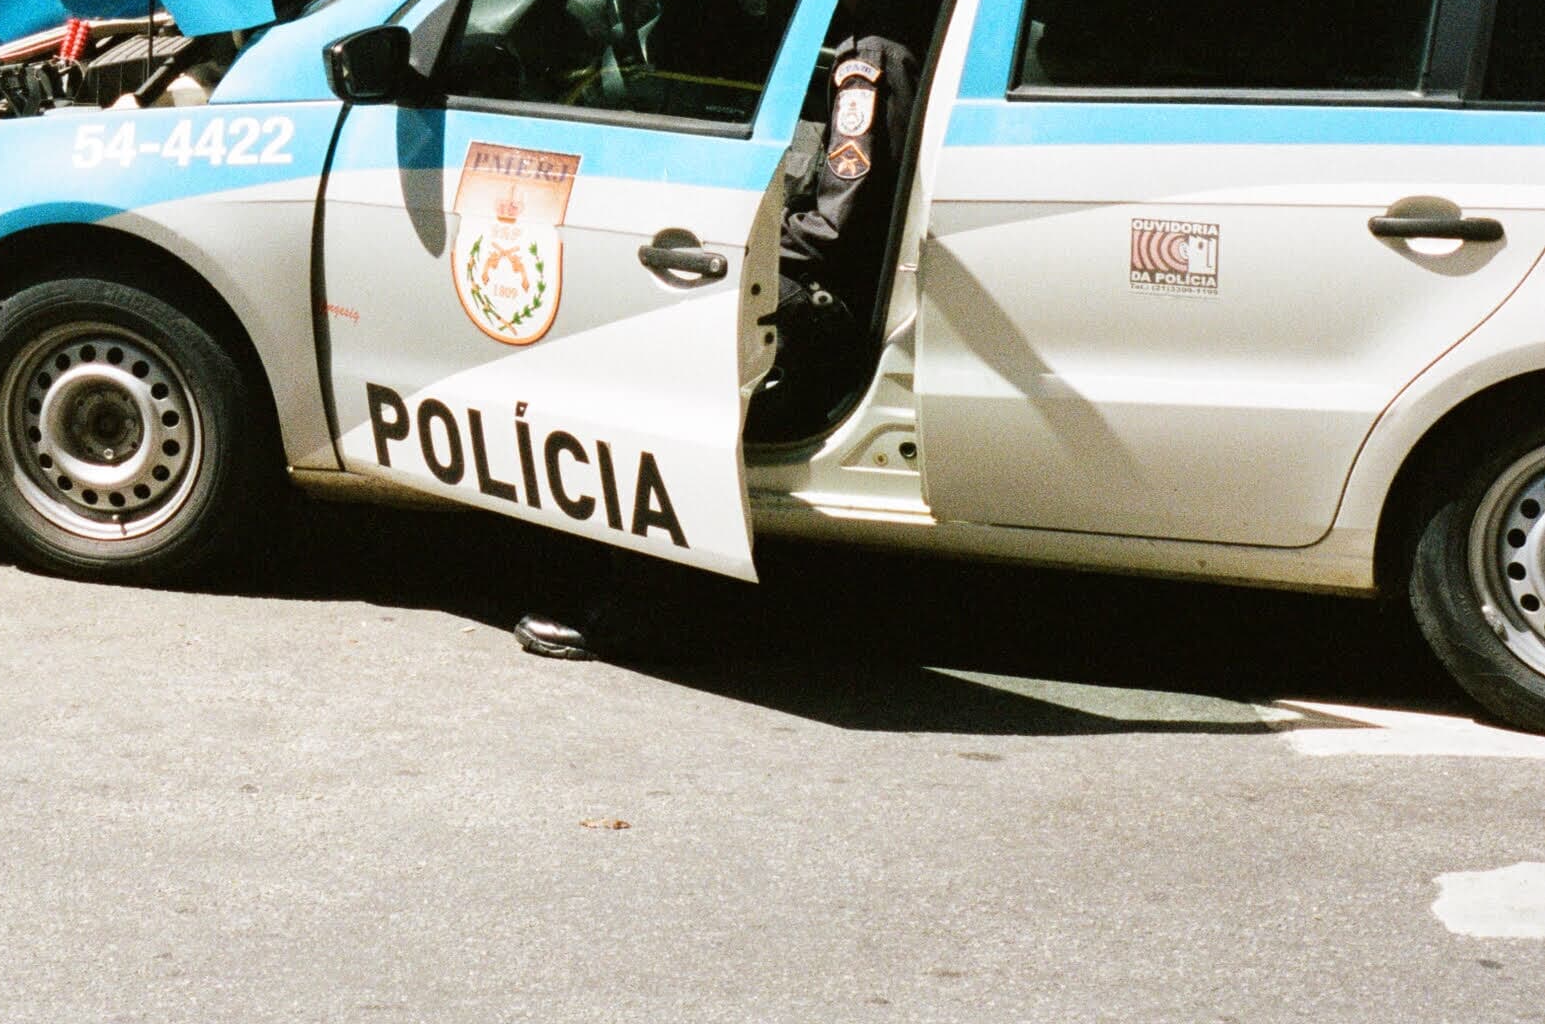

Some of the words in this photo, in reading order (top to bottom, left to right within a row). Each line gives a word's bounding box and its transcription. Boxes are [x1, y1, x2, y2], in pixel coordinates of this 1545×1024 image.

[71, 116, 295, 169] 54-4422
[472, 151, 570, 183] PMERJ
[1132, 219, 1219, 236] OUVIDORIA
[1131, 270, 1151, 283] DA
[1155, 272, 1218, 288] POLÍCIA
[365, 380, 691, 550] POLÍCIA
